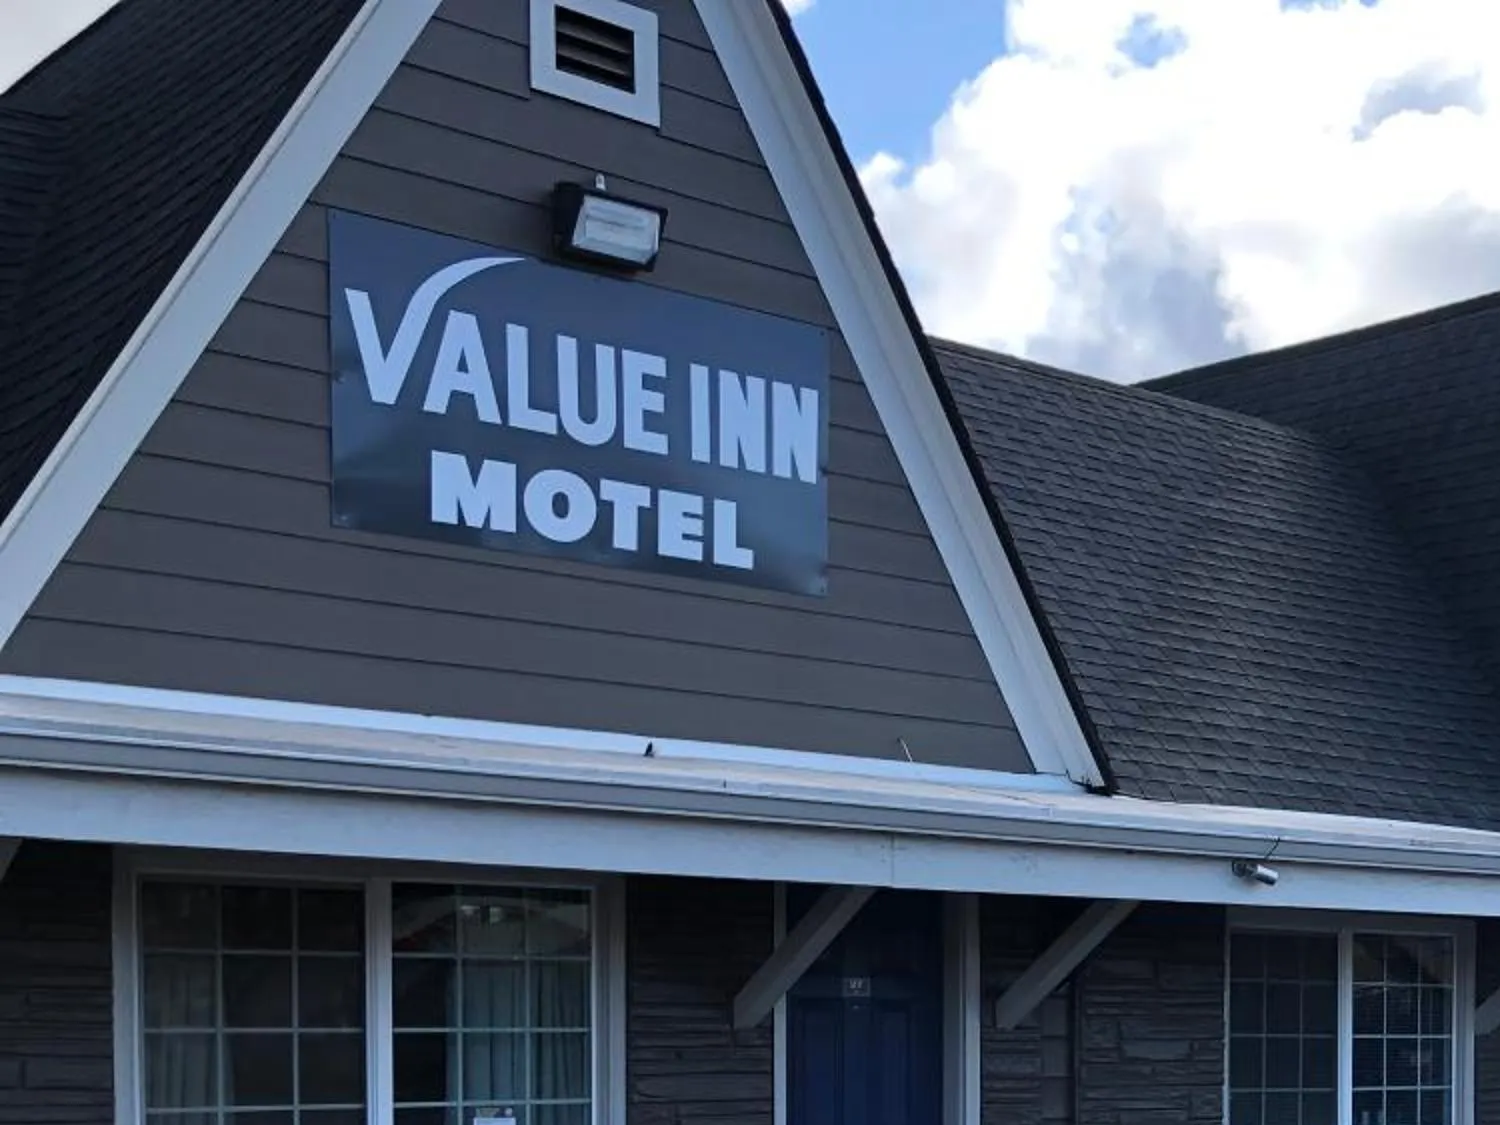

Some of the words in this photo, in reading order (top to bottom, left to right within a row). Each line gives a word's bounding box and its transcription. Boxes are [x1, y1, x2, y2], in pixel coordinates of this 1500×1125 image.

[345, 257, 669, 456] VALUE
[689, 363, 819, 484] INN
[431, 450, 754, 570] MOTEL
